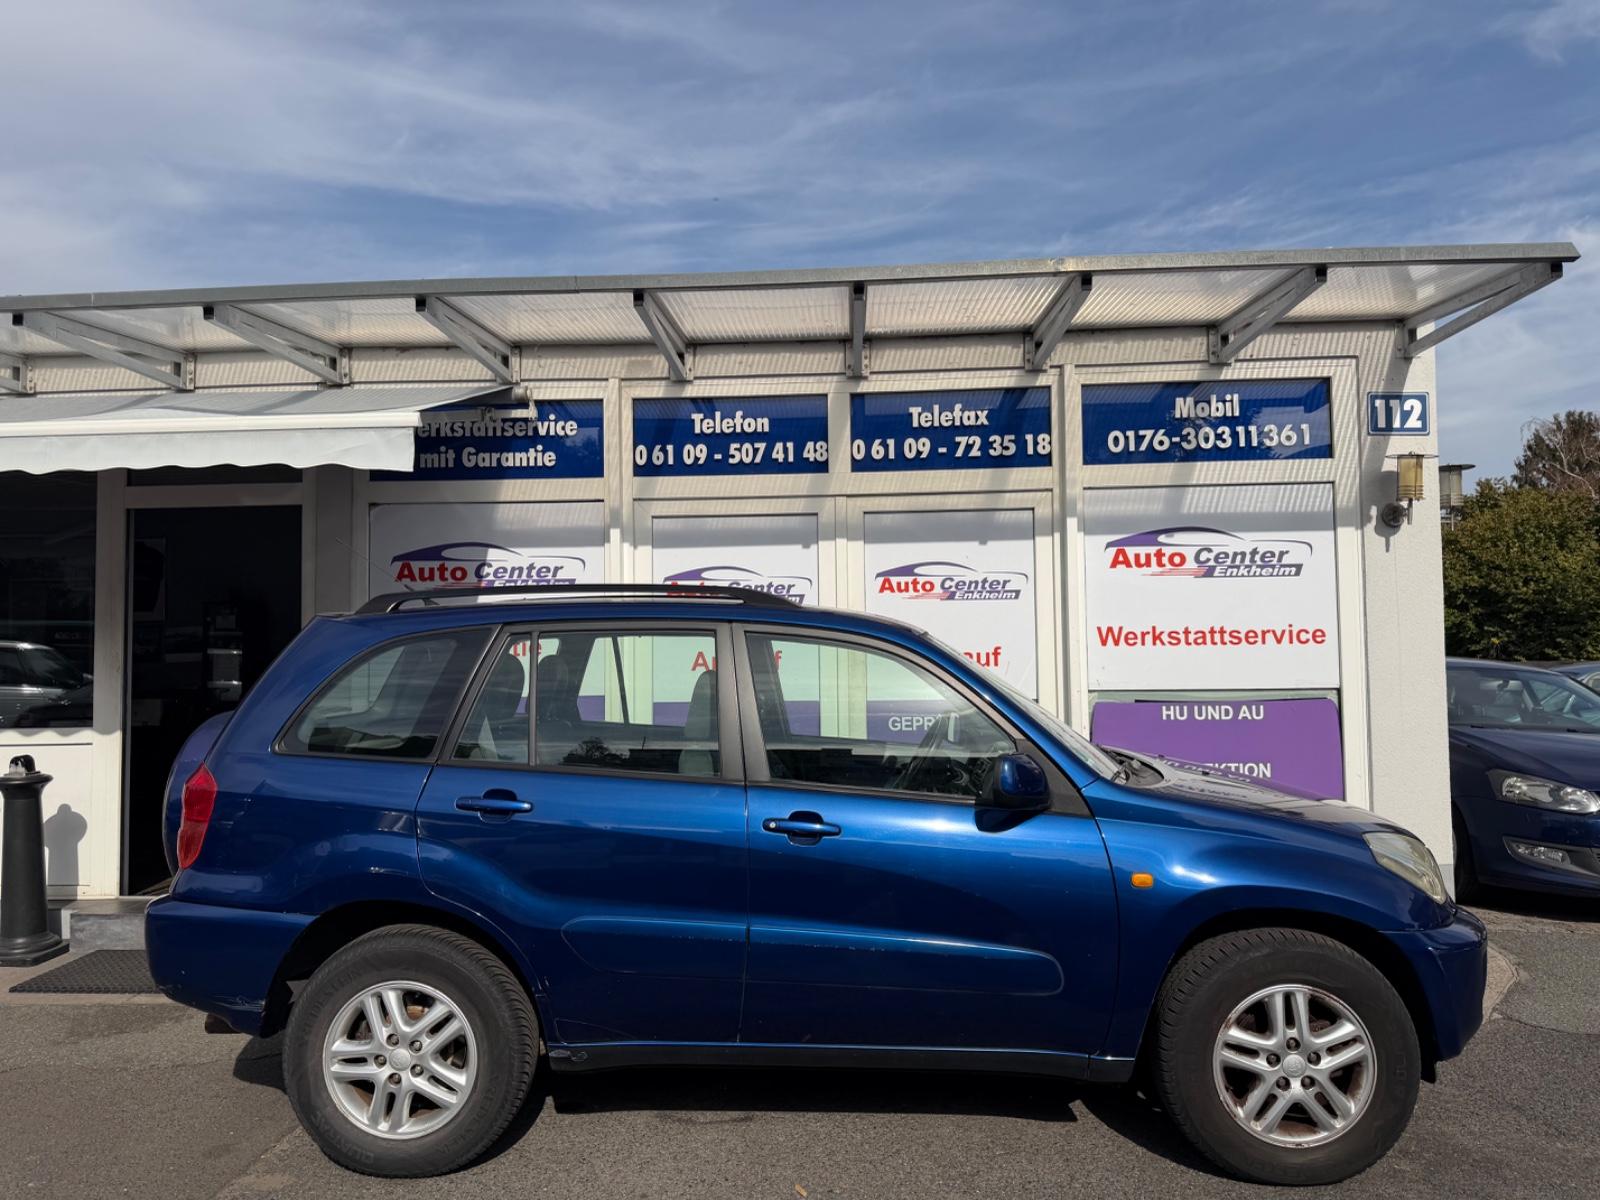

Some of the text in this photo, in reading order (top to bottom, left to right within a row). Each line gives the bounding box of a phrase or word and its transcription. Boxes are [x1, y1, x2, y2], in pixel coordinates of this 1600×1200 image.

[909, 403, 989, 427] Telefax
[1174, 393, 1240, 419] Mobil
[1374, 399, 1423, 429] 112
[417, 413, 578, 437] erkstattservice
[691, 411, 769, 434] Telefon
[852, 438, 866, 460] 0
[871, 438, 895, 460] 61
[903, 437, 931, 459] 09
[955, 436, 982, 458] 72
[988, 434, 1016, 457] 35
[1025, 433, 1051, 455] 18
[1107, 423, 1311, 453] 0176-30311361
[419, 444, 557, 468] mit Garantie
[635, 444, 648, 466] 0
[652, 444, 675, 466] 61
[682, 443, 708, 466] 09
[728, 442, 767, 465] 507
[771, 441, 794, 463] 41
[803, 440, 828, 462] 48
[1109, 547, 1290, 568] Auto Center
[394, 561, 564, 583] Auto Center
[1213, 565, 1297, 577] Enkheim
[878, 576, 1012, 593] Auto Center
[954, 590, 1017, 600] Enkheim
[1096, 624, 1327, 647] Werkstattservice
[1162, 705, 1265, 720] HU UND AU
